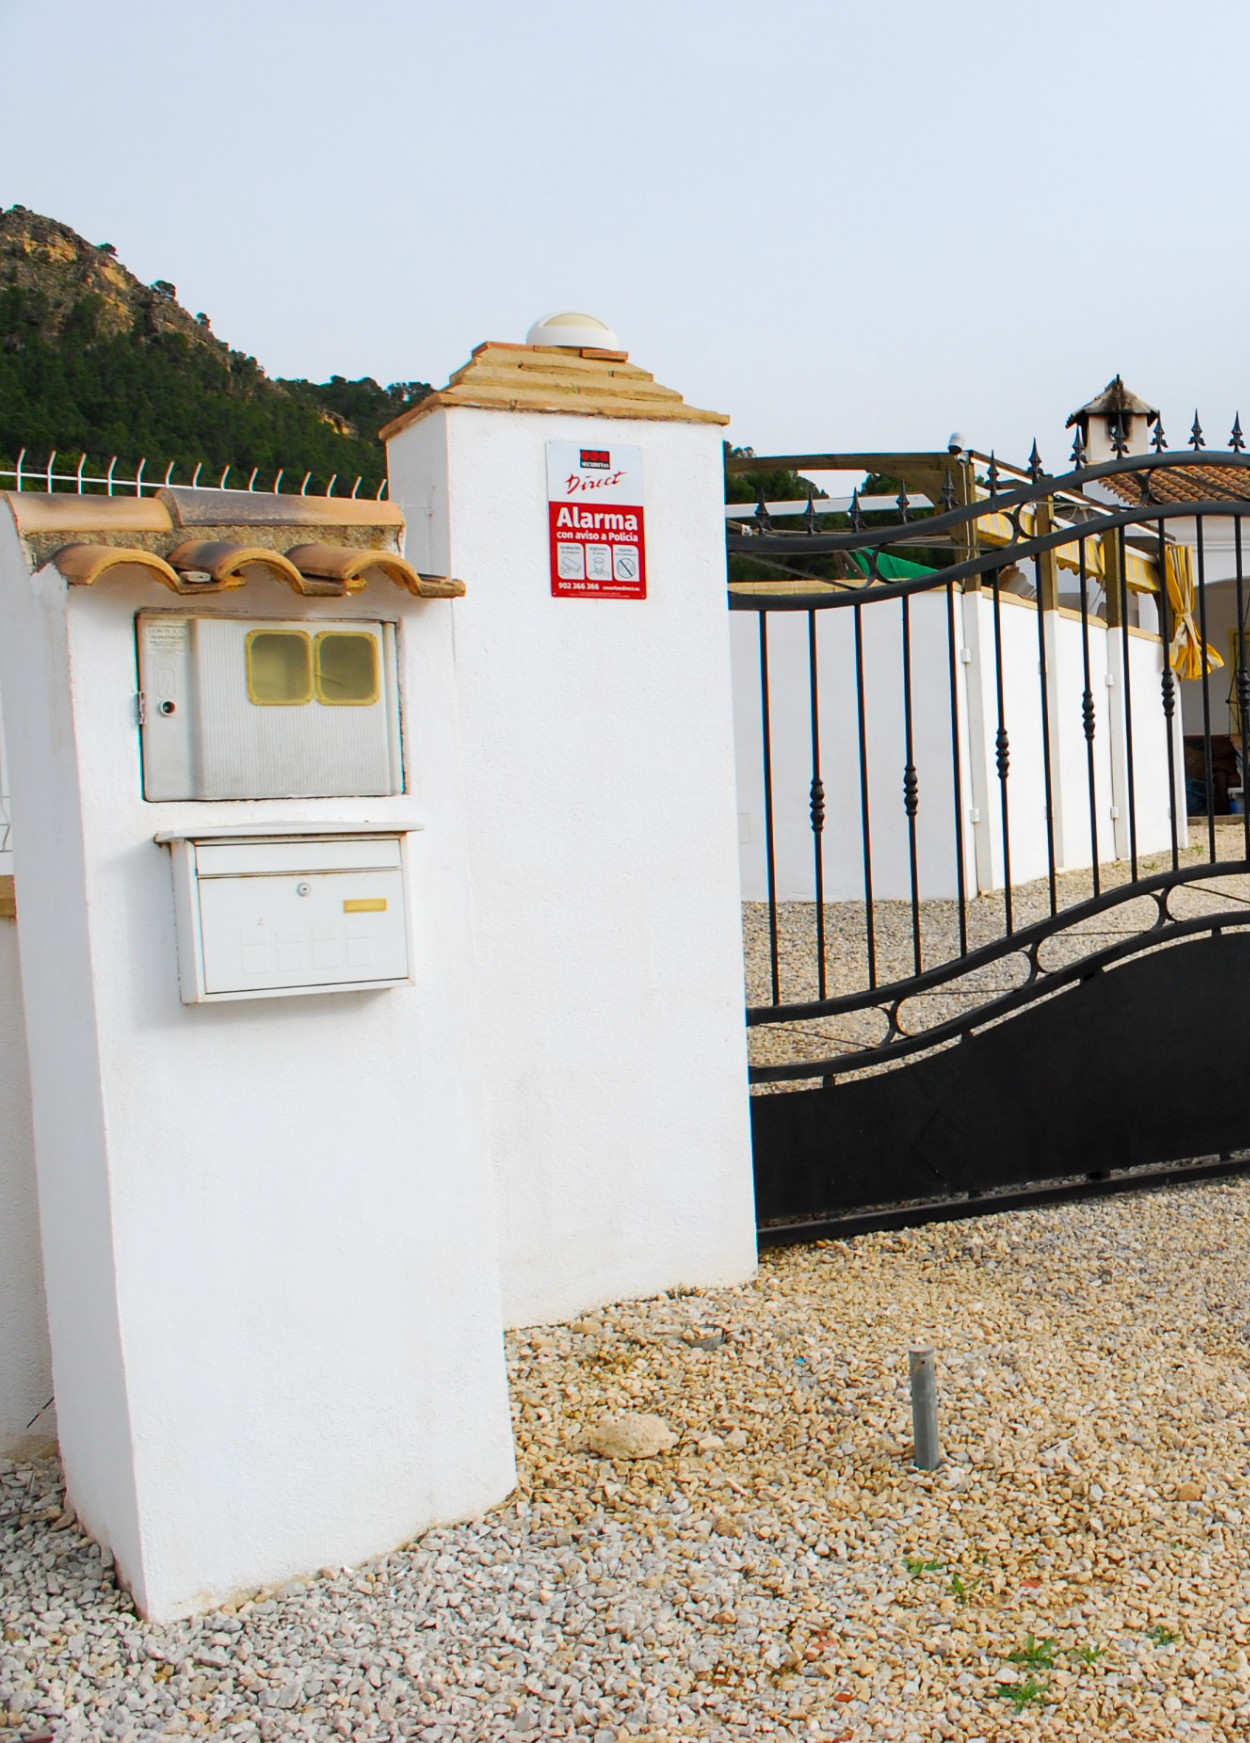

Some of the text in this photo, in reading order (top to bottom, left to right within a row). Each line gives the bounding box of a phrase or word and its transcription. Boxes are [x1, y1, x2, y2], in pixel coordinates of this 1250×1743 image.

[564, 470, 628, 495] Direct
[556, 506, 638, 531] Alarma
[556, 531, 574, 539] con
[575, 530, 599, 540] aviso
